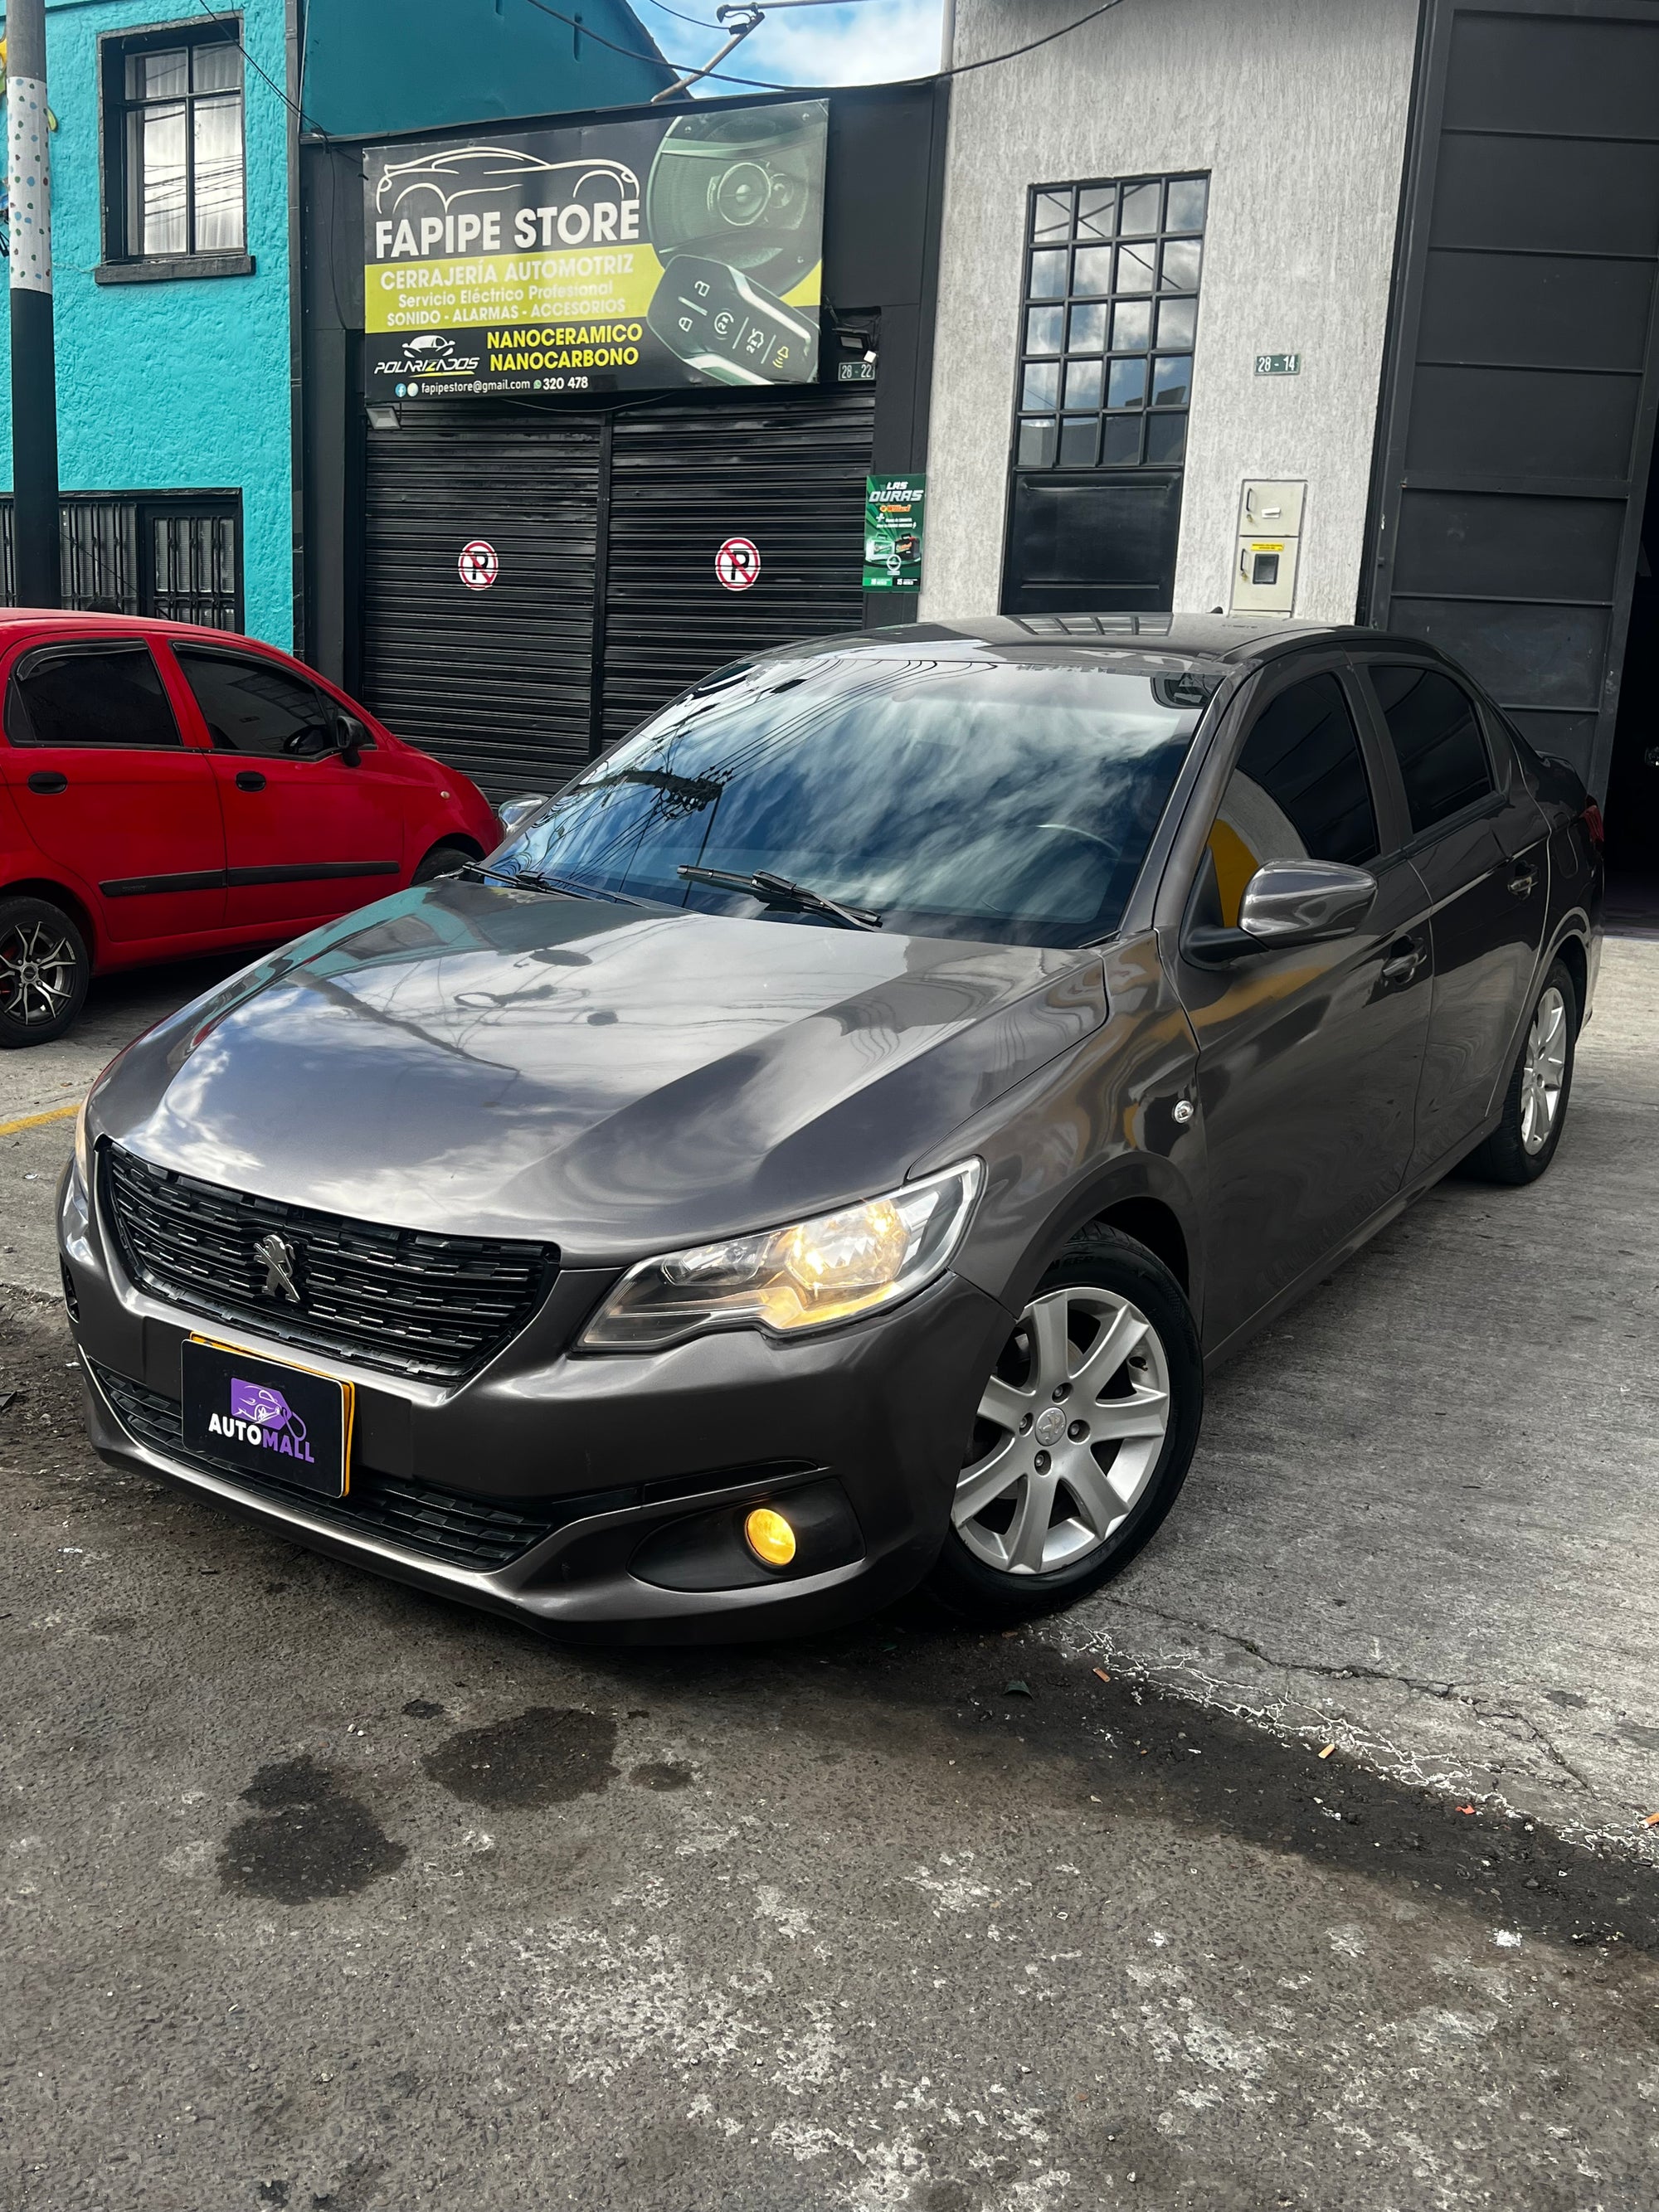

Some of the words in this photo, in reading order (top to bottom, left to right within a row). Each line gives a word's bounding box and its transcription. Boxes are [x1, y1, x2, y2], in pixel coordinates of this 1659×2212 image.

[376, 211, 501, 259] FAPIPE
[513, 199, 640, 249] STORE
[380, 260, 498, 290] CERRAJERÍA
[504, 253, 635, 282] AUTOMOTRIZ
[398, 291, 456, 308] Servicio
[460, 287, 524, 304] Eléctrico
[528, 280, 613, 299] Profesional
[387, 309, 441, 327] SONIDO
[452, 304, 519, 323] ALARMAS
[531, 299, 625, 318] ACCESORIOS
[487, 323, 643, 349] NANOCERAMICO
[374, 357, 480, 375] POLARIZADOS
[490, 347, 640, 372] NANOCARBONO
[841, 364, 853, 379] 28
[860, 363, 872, 378] 22
[1258, 356, 1272, 372] 28
[1283, 355, 1296, 372] 14
[421, 379, 531, 396] fapipestore@gmail.com
[542, 377, 565, 391] 320
[567, 376, 590, 389] 478
[868, 489, 924, 503] DURAS
[886, 481, 908, 490] LAS
[208, 1412, 315, 1464] AUTOMALL
